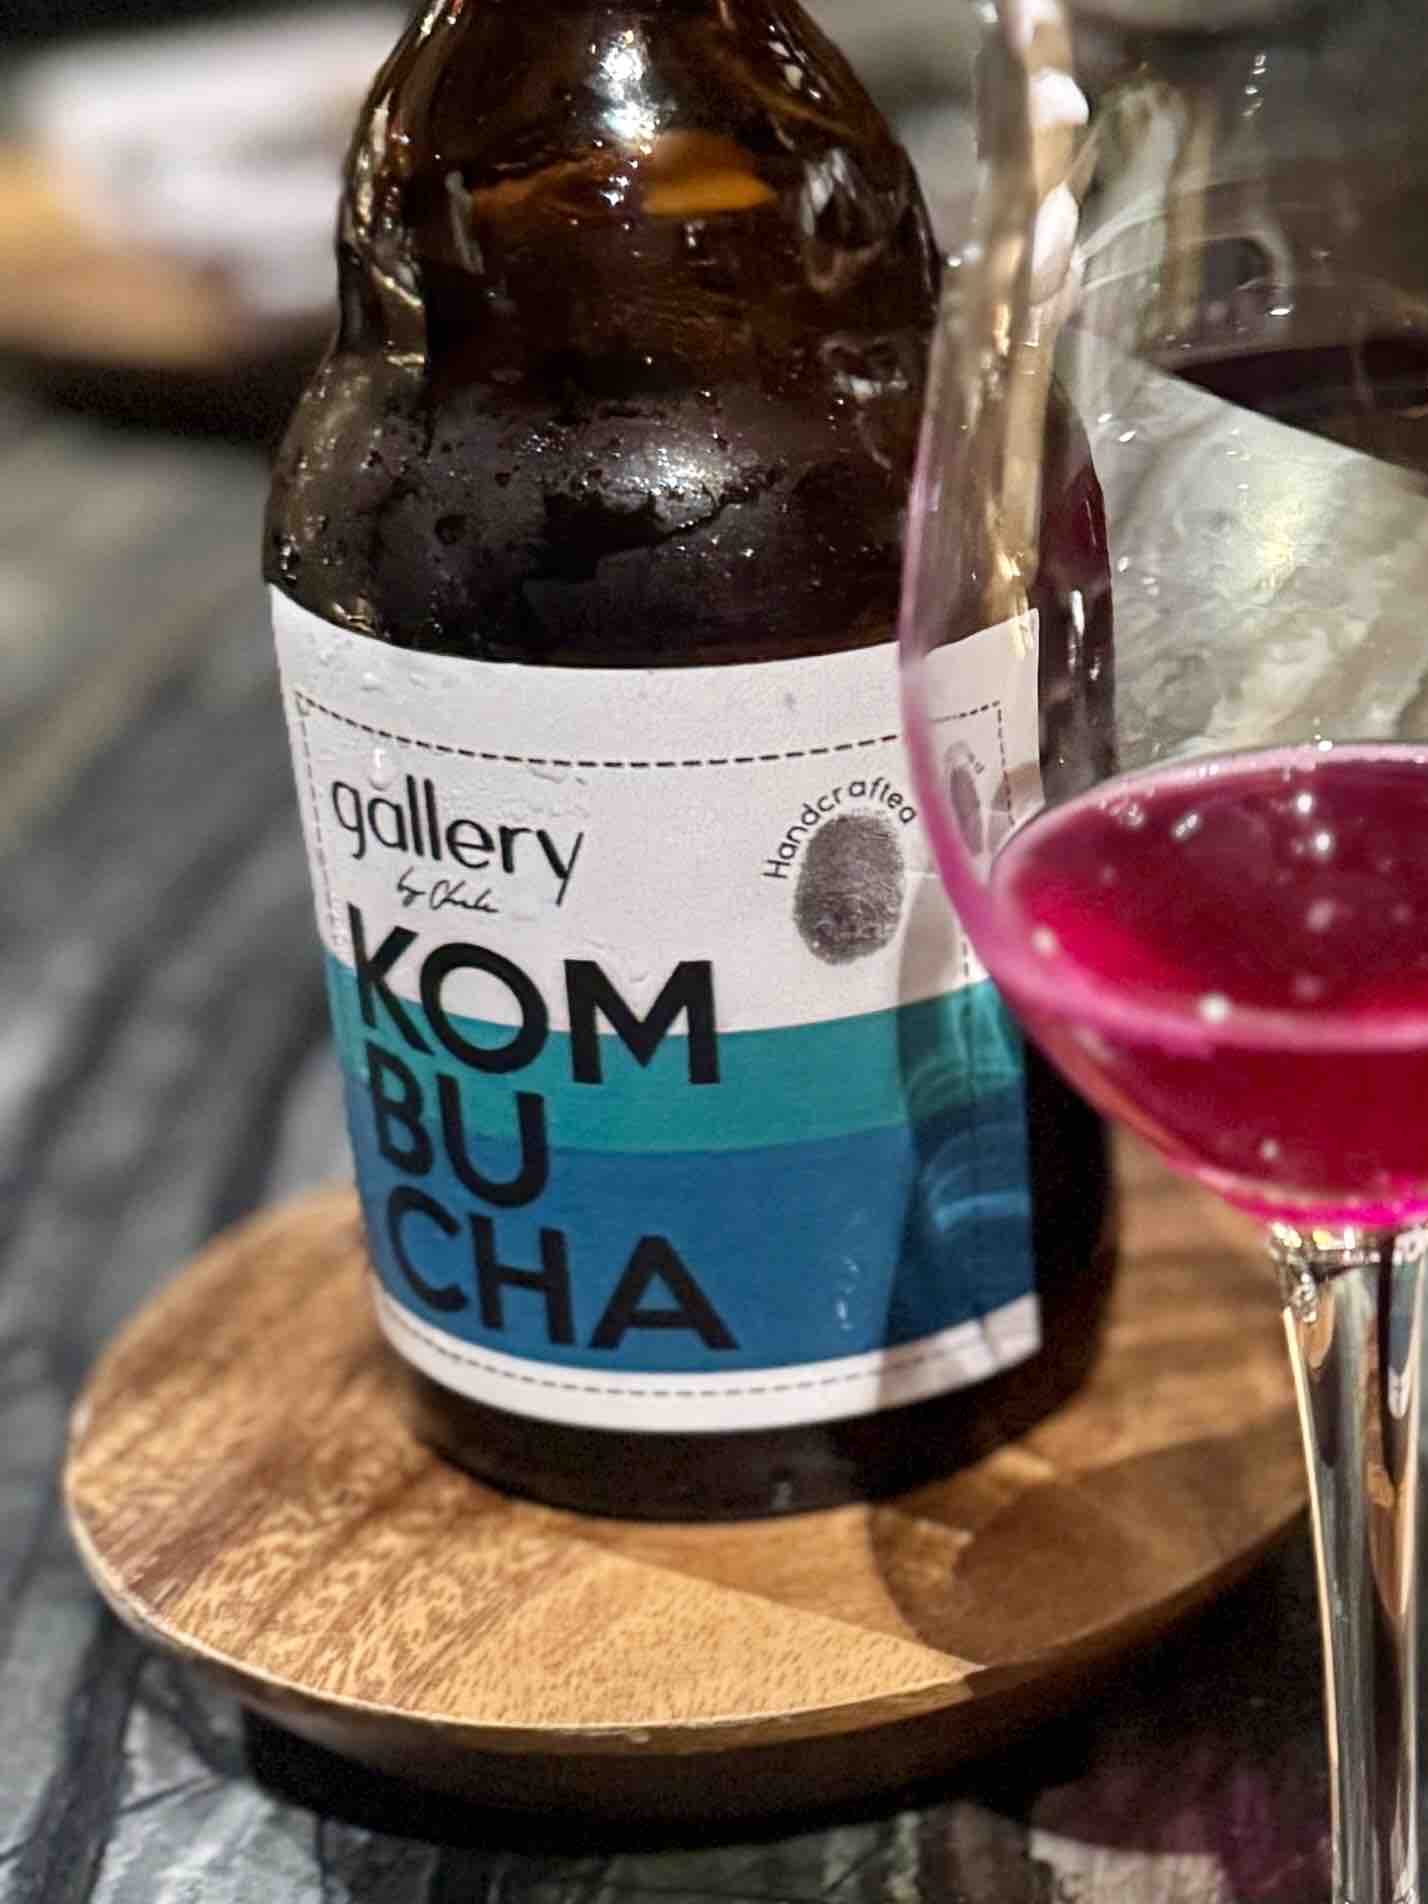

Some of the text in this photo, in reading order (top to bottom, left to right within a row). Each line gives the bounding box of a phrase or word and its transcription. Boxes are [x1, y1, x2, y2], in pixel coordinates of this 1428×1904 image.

[331, 774, 584, 907] gallery
[347, 902, 721, 1085] KOM
[369, 1045, 549, 1208] BU
[387, 1185, 739, 1352] CHA
